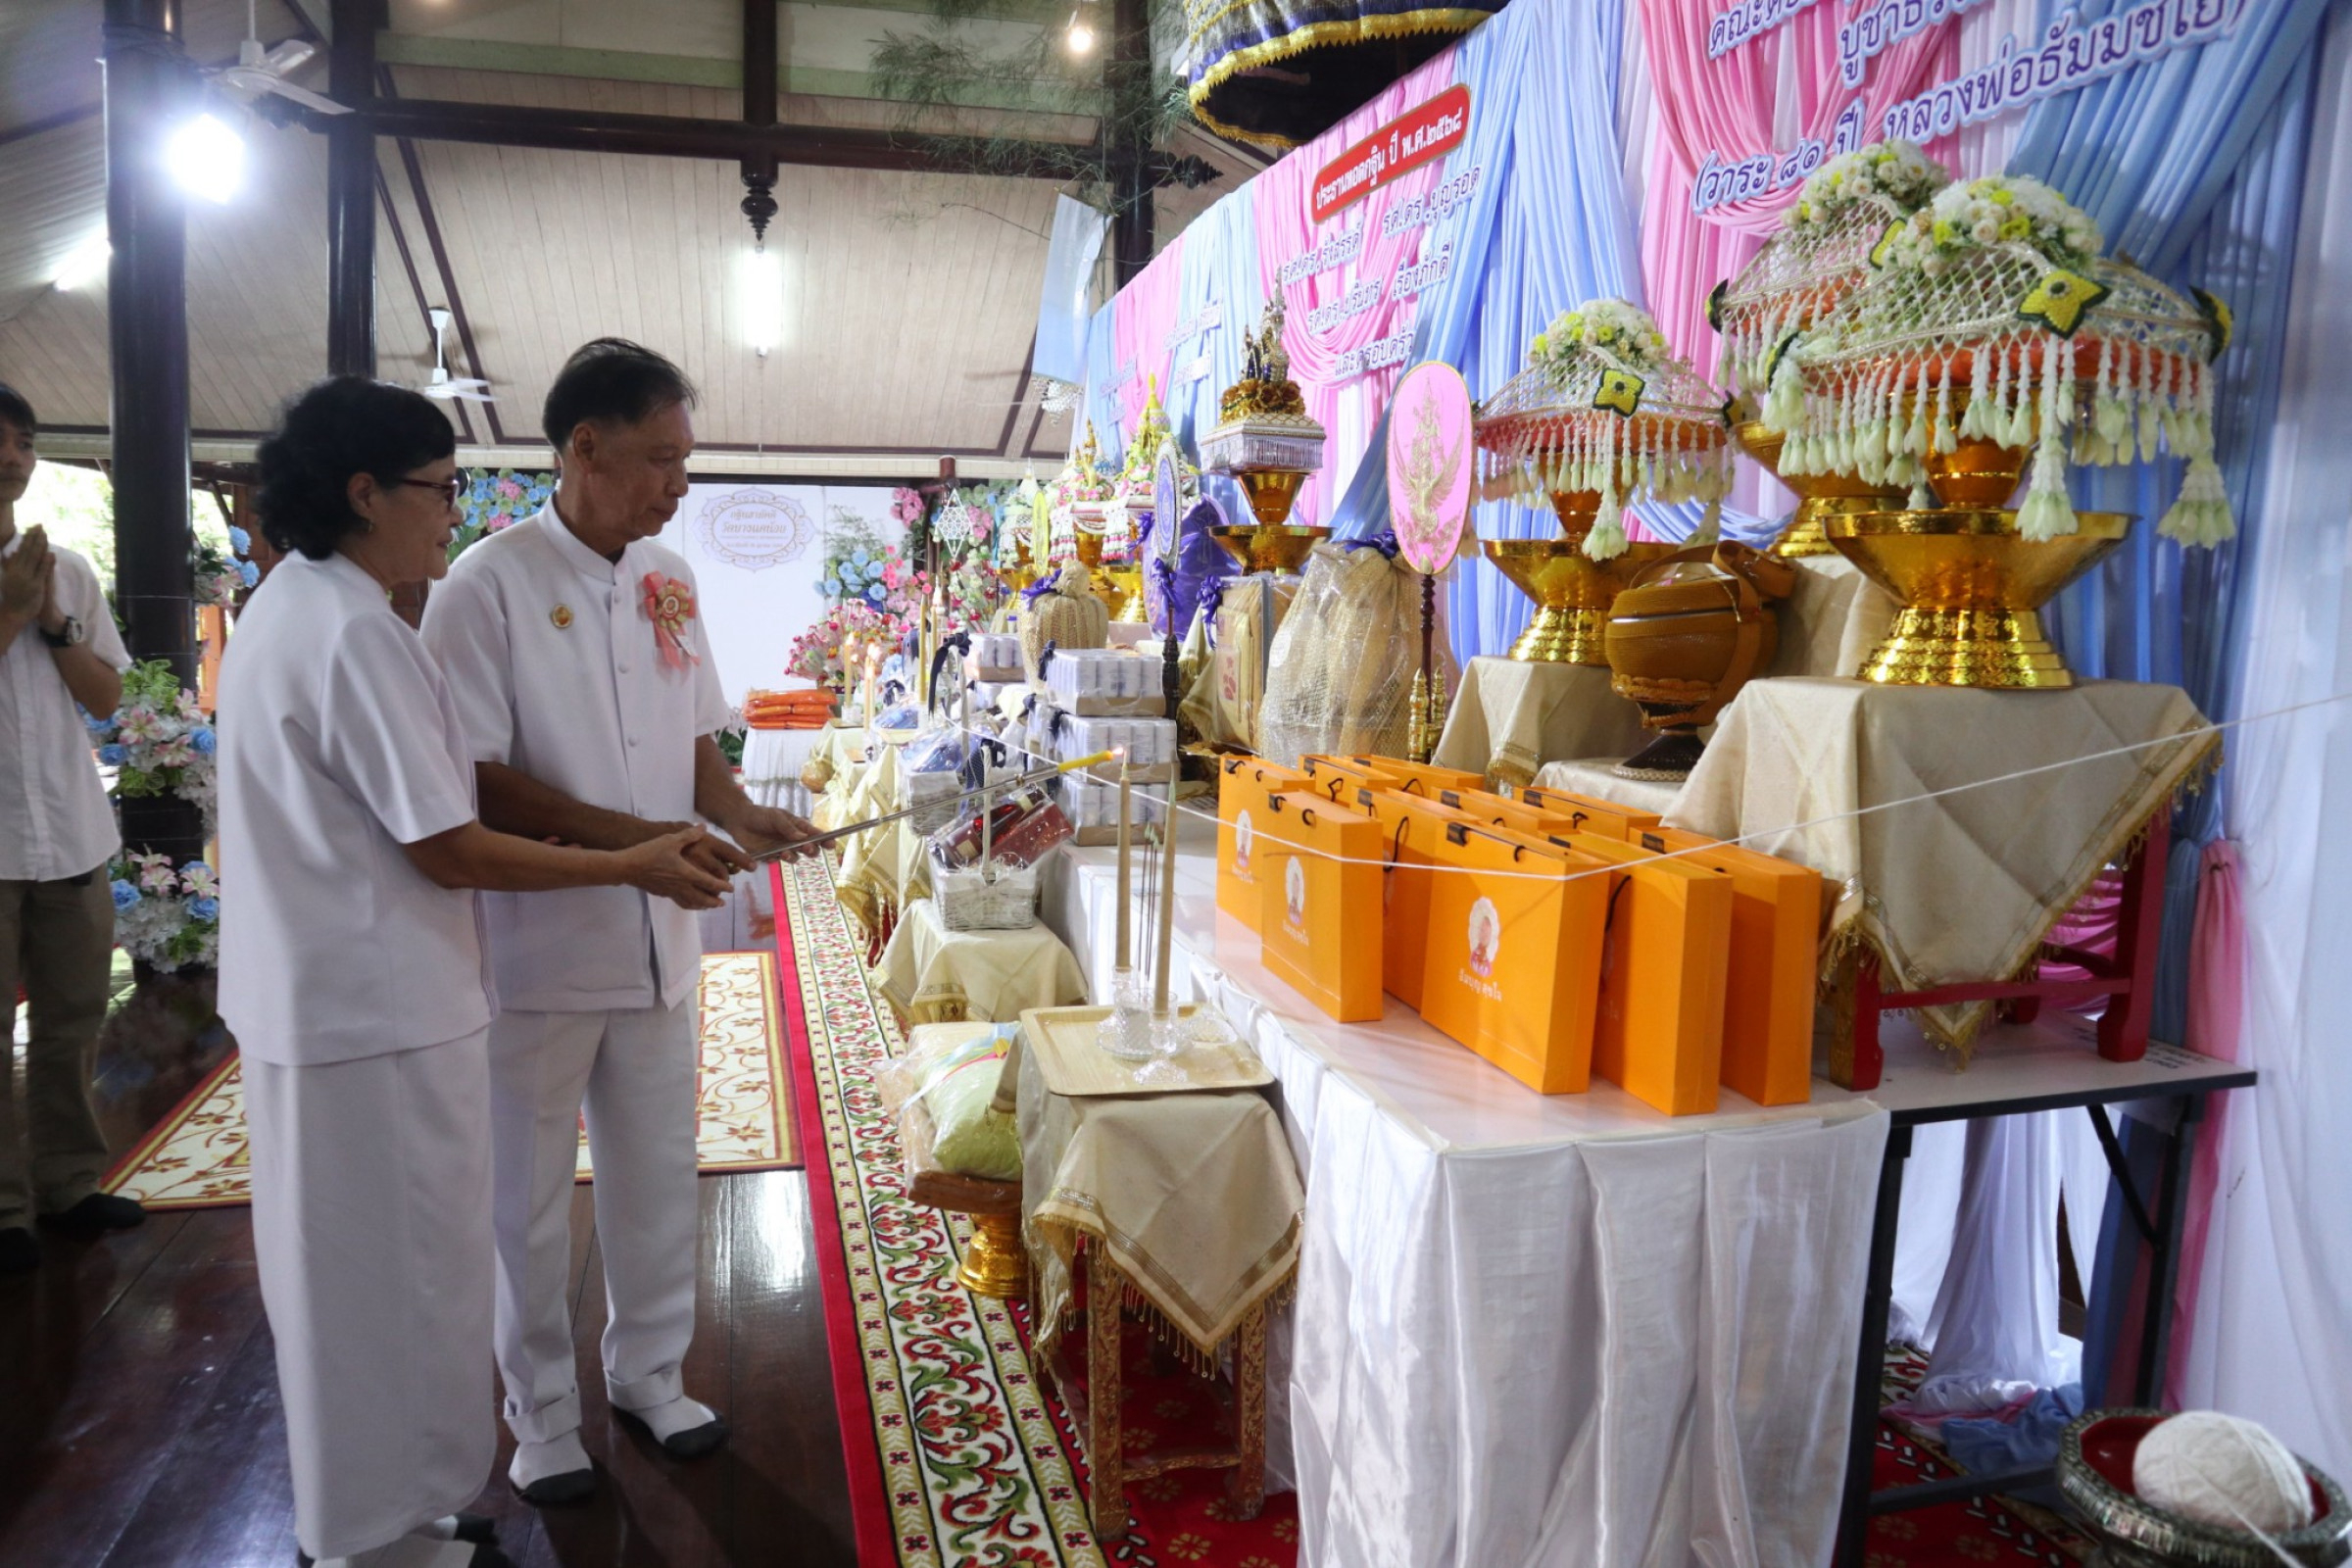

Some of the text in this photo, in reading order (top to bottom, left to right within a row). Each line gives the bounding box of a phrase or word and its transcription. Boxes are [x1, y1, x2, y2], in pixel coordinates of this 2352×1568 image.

[1315, 145, 1386, 211] ประธานทอดกฐิน
[1389, 128, 1398, 166] ปี
[1696, 162, 1767, 207] (วาระ
[1780, 146, 1820, 181] ๘๑
[1837, 105, 1859, 156] ปี
[1335, 322, 1414, 376] และครอบครัว
